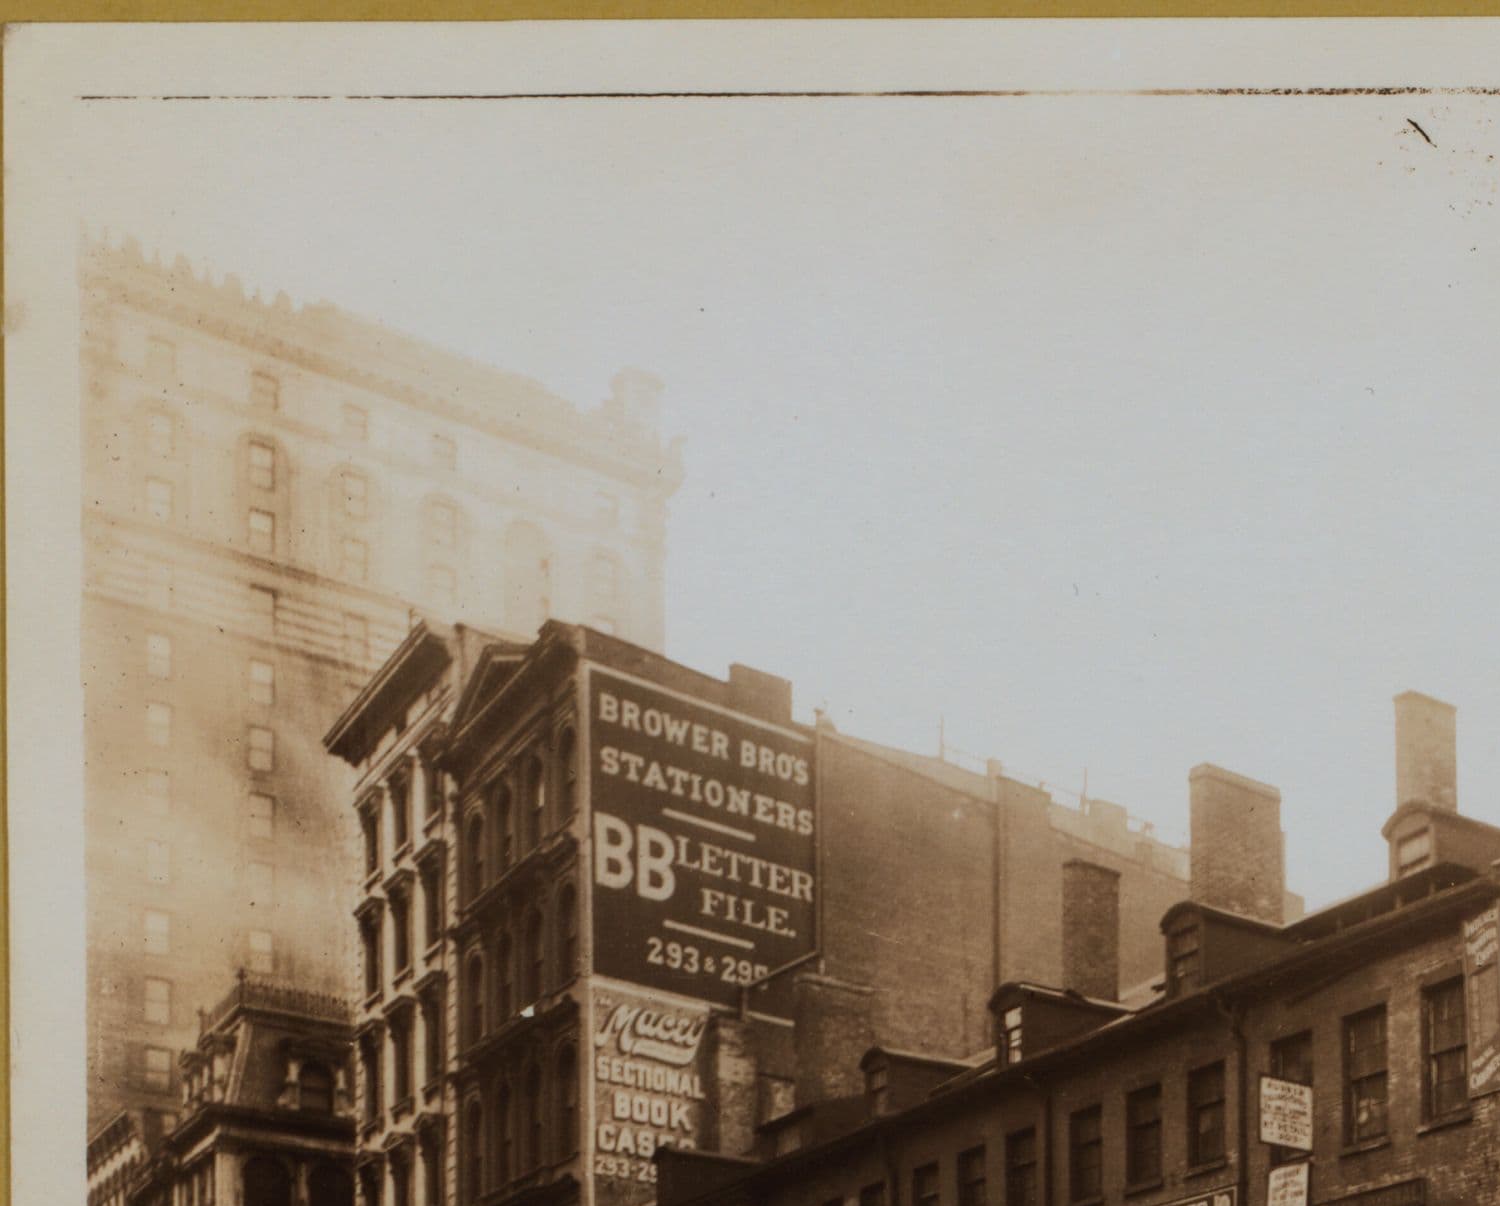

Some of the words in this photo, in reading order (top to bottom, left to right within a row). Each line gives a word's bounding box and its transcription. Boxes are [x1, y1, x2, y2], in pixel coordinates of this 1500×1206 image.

[599, 692, 729, 760] BROWER
[740, 741, 810, 787] BRO'S
[600, 746, 814, 836] STATIONERS
[594, 811, 676, 901] BB
[675, 835, 814, 902] LETTER
[647, 937, 700, 974] 293
[704, 956, 716, 972] &
[595, 1055, 706, 1098] SECTIONAL
[613, 1090, 693, 1131] BOOK
[597, 1124, 696, 1158] CAS
